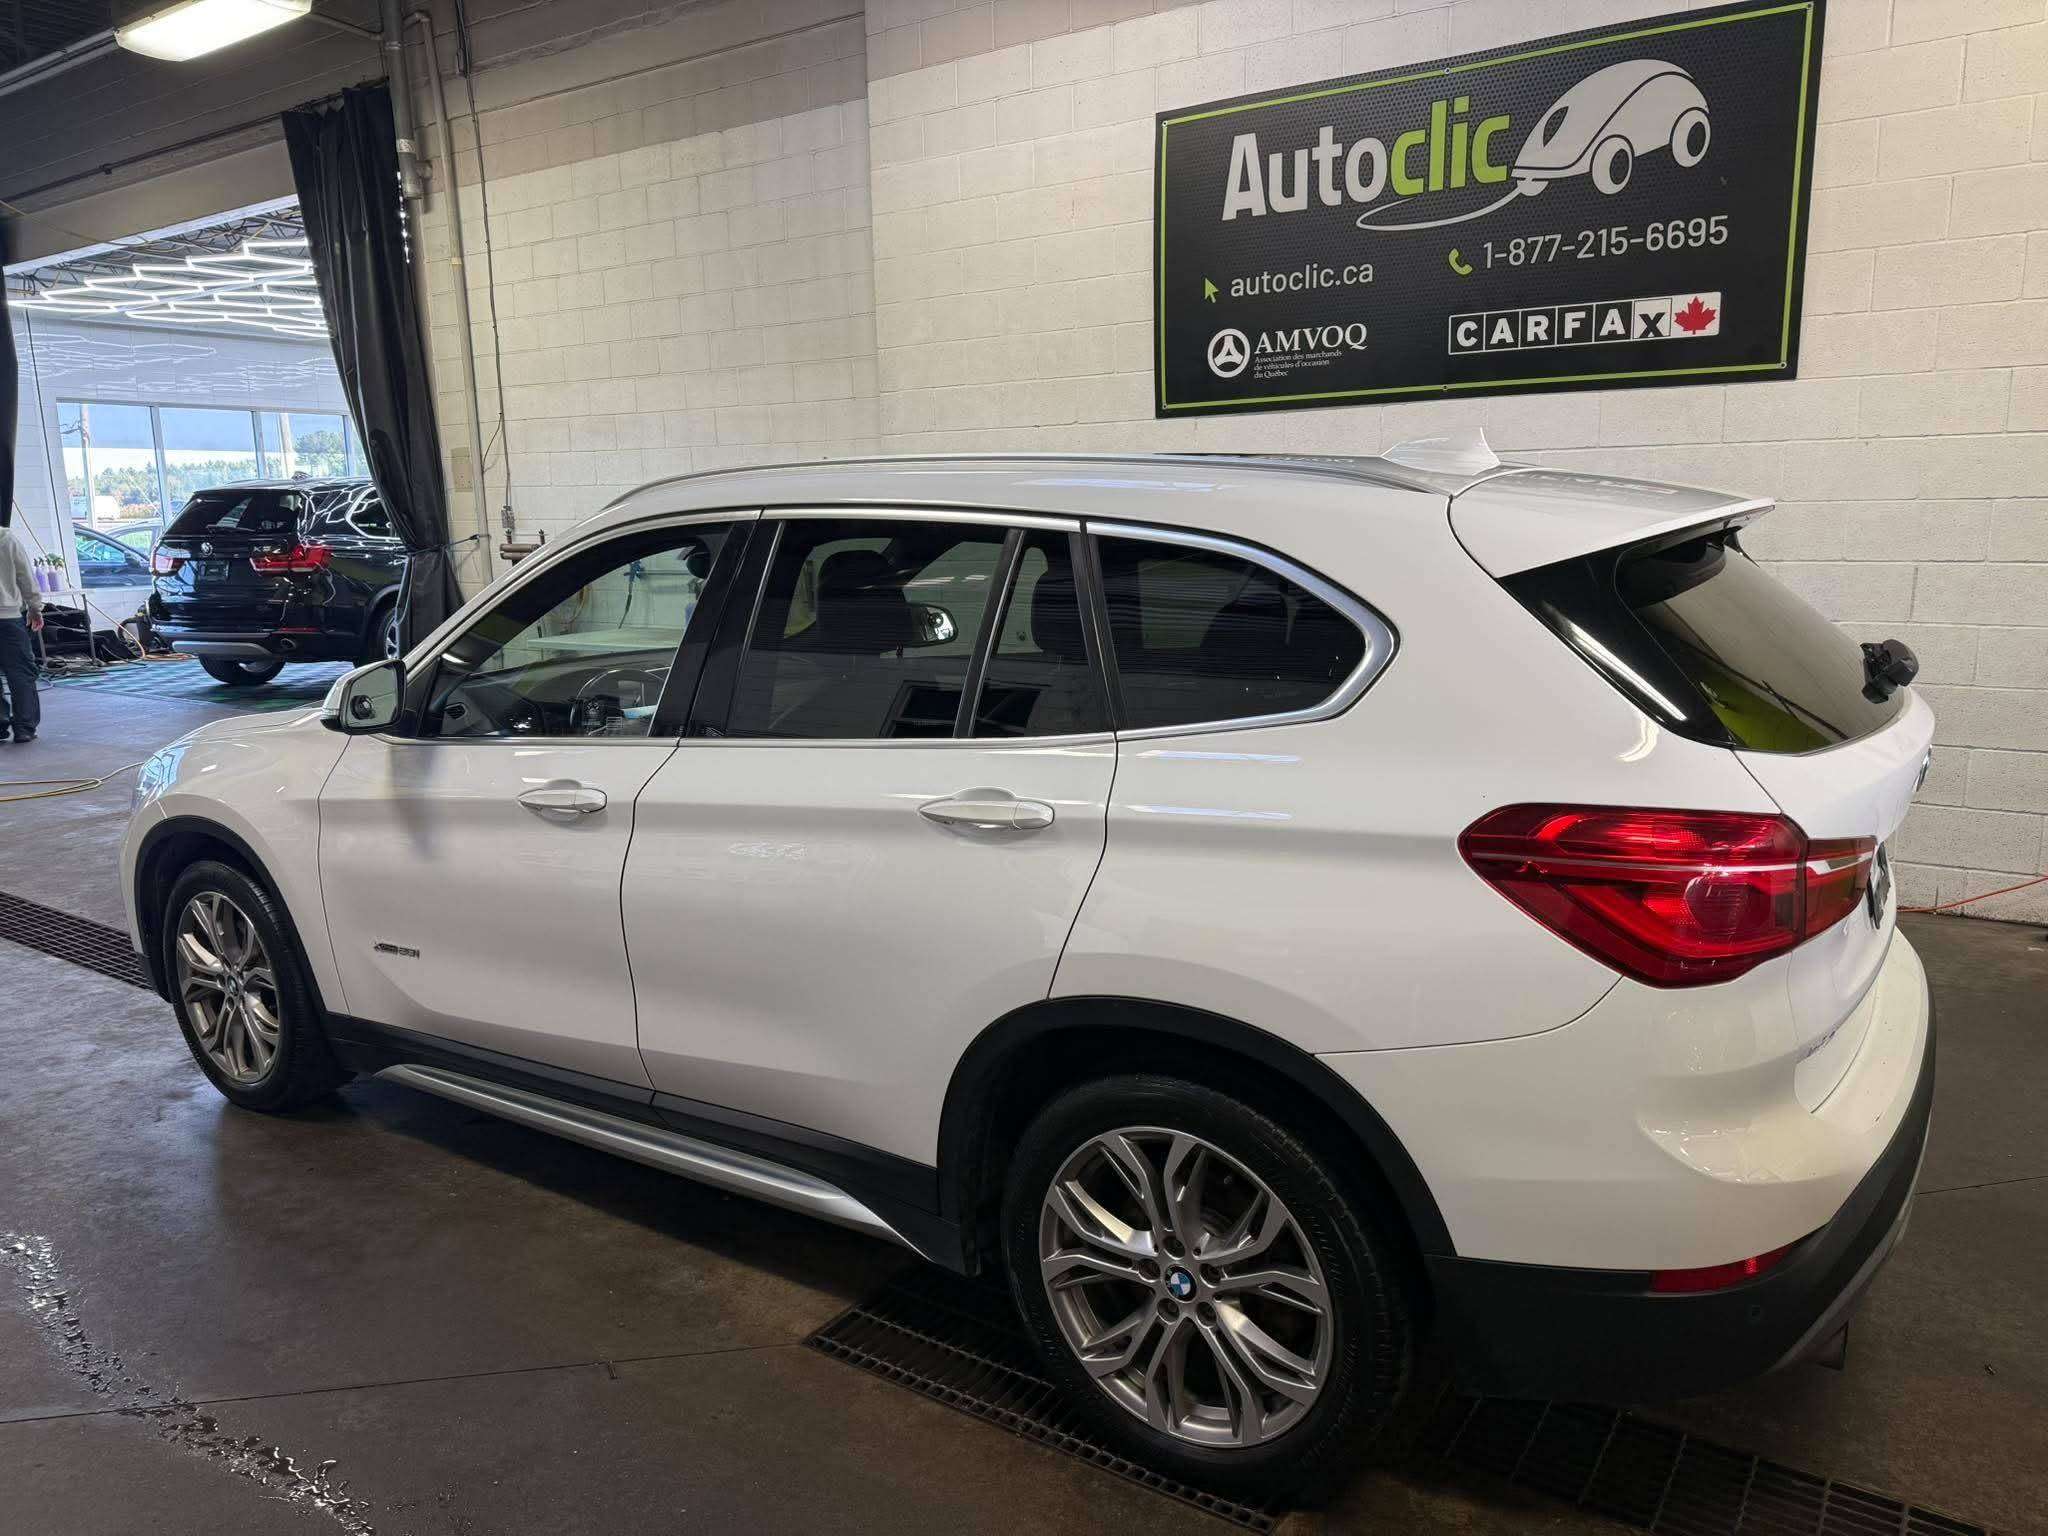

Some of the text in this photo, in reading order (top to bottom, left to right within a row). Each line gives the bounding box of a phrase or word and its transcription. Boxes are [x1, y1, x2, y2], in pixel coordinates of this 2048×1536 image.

[1221, 95, 1511, 221] Autoclic
[1483, 214, 1729, 269] 1-877-215-6695
[1230, 263, 1374, 297] autoclic.ca
[1254, 322, 1368, 354] AMVOQ
[1455, 308, 1666, 347] CARFAX
[1253, 359, 1330, 371] de véhicules d'occasion
[1254, 349, 1342, 363] Association des marchands
[1253, 370, 1289, 379] du Québec
